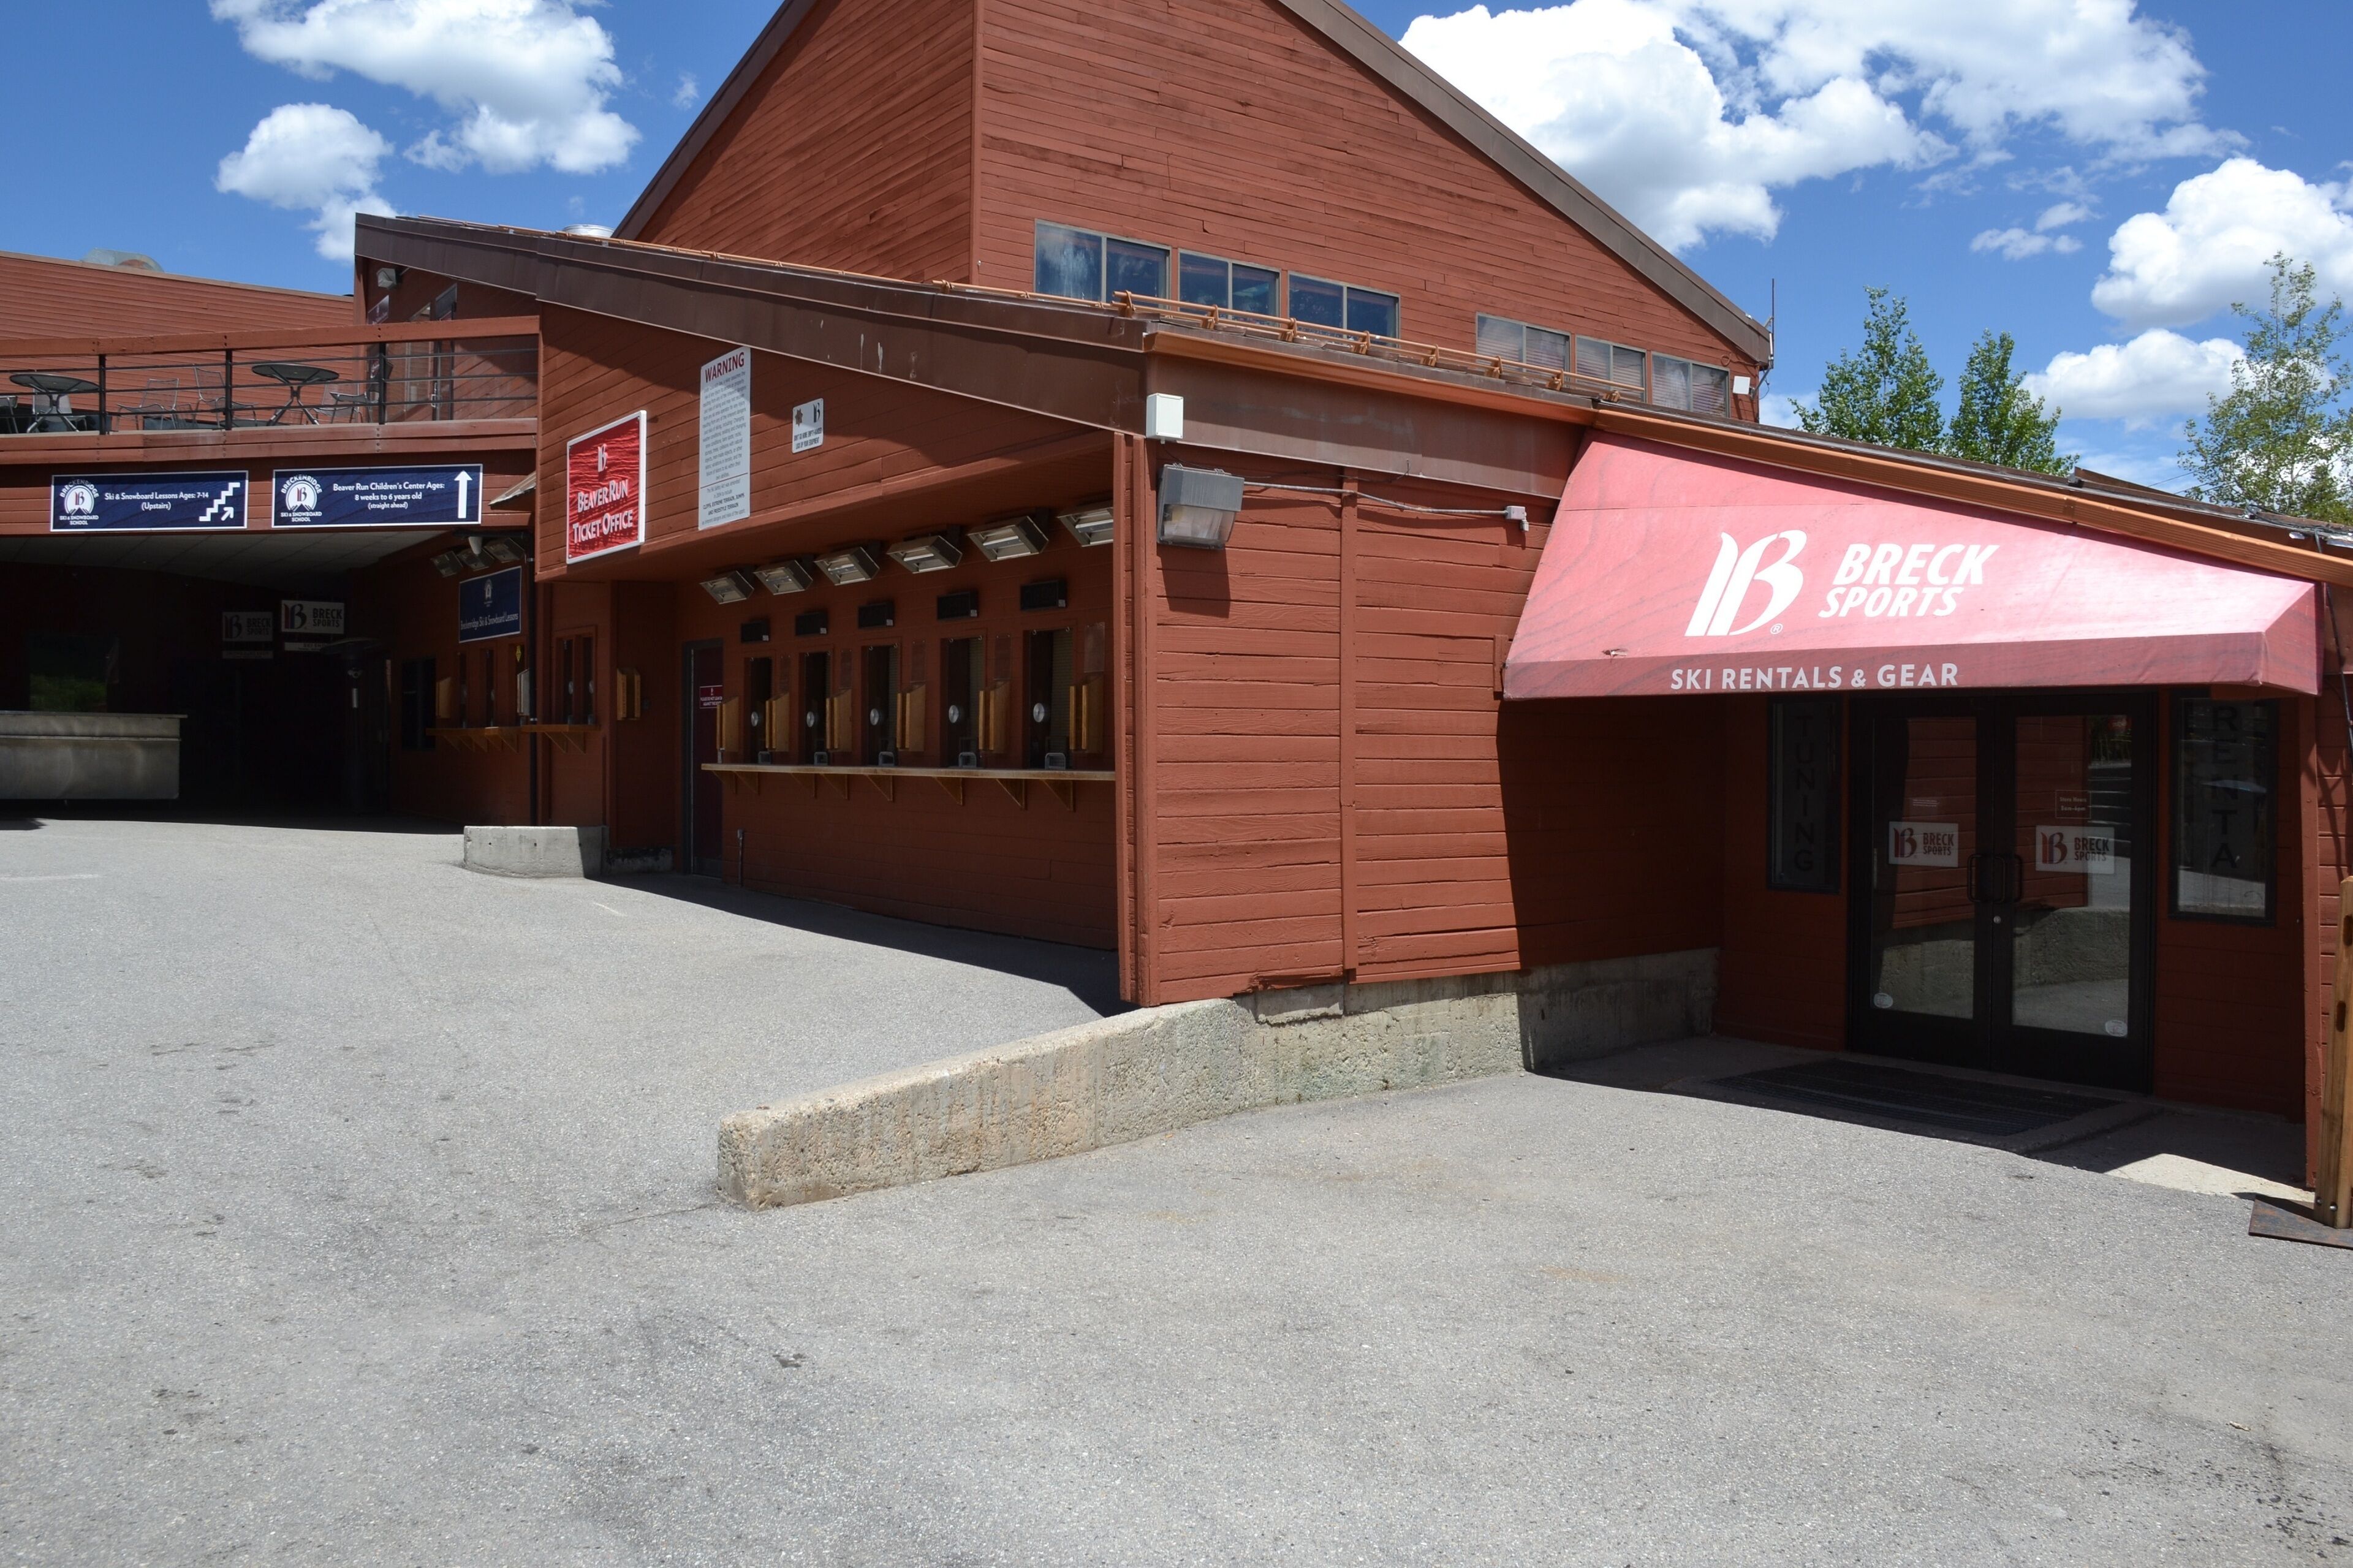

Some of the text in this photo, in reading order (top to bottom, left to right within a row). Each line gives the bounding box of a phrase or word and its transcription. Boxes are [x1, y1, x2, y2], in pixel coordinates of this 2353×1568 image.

[705, 352, 745, 383] WARNING
[59, 479, 99, 498] BRECKENRIDGE
[281, 474, 323, 494] BRECKENRIDGE
[369, 482, 402, 490] Children's
[403, 481, 426, 490] Center
[426, 481, 445, 491] Ages:
[178, 491, 195, 501] Ages:
[141, 502, 172, 511] (Upstairs)
[1832, 543, 2000, 585] BRECK
[1817, 586, 1965, 618] SPORTS
[313, 608, 343, 619] BRECK
[246, 618, 271, 628] BRECK
[313, 619, 339, 627] SPORTS
[1670, 662, 1959, 690] SKI RENTALS & GEAR
[1794, 714, 1815, 872] TUNING
[1923, 833, 1954, 846] BRECK
[2074, 837, 2109, 852] BRECK
[1923, 846, 1952, 855] SPORTS
[2074, 851, 2107, 862] SPORTS
